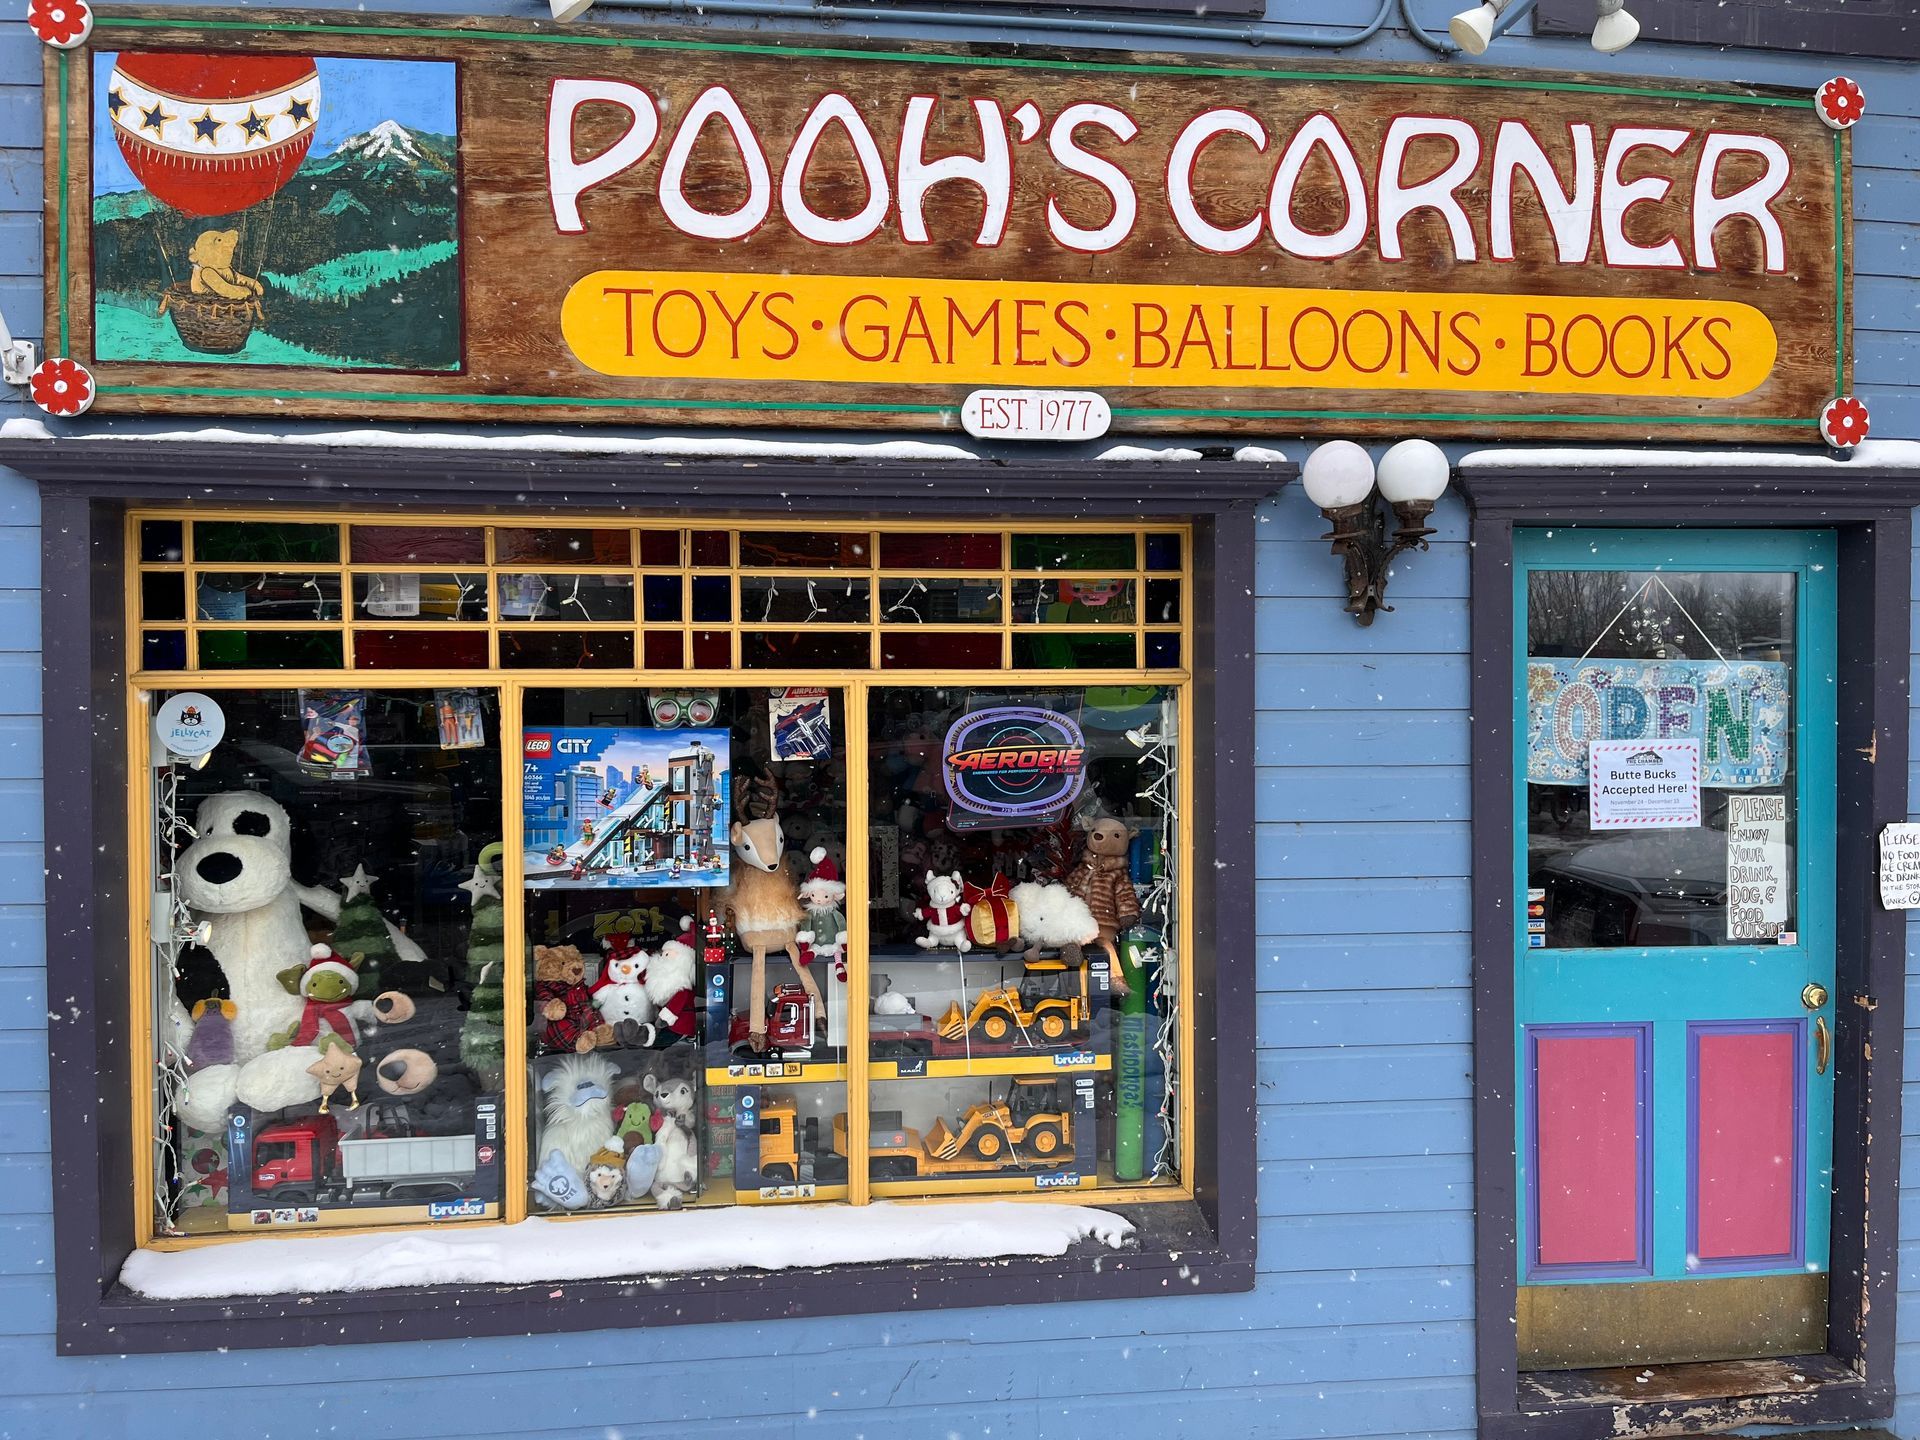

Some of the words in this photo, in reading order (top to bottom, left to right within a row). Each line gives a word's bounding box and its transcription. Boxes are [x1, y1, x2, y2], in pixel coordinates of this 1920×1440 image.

[545, 77, 1139, 254] POOH'S
[1164, 105, 1792, 274] CORNER
[602, 287, 800, 361] TOYS
[838, 293, 1092, 368] GAMES
[1131, 301, 1482, 377] BALLOONS
[1520, 312, 1734, 382] BOOKS
[978, 397, 1029, 433] EST.
[1037, 399, 1094, 432] 1977
[1552, 681, 1754, 766] OPEN
[526, 740, 551, 752] LEGO
[556, 738, 593, 754] CITY
[948, 747, 1085, 771] AEROBIE
[524, 763, 539, 773] 7+
[1610, 770, 1642, 780] Butte
[1644, 769, 1677, 780] Bucks
[1602, 783, 1655, 797] Accepted
[1657, 783, 1688, 794] Here!
[1730, 797, 1785, 822] PLEASE
[1882, 827, 1920, 846] PLEASE
[1728, 844, 1766, 864] YOUR
[1882, 850, 1895, 861] NO
[1897, 850, 1920, 860] FOOD
[1729, 865, 1778, 884] DRINK,
[1881, 861, 1896, 873] ICE
[1881, 873, 1894, 883] OR
[1729, 904, 1764, 924] FOOD
[714, 990, 724, 998] 3+
[1054, 1053, 1095, 1065] bruder
[743, 1112, 753, 1121] 3+
[1035, 1175, 1079, 1187] bruder
[430, 1202, 484, 1216] bruder
